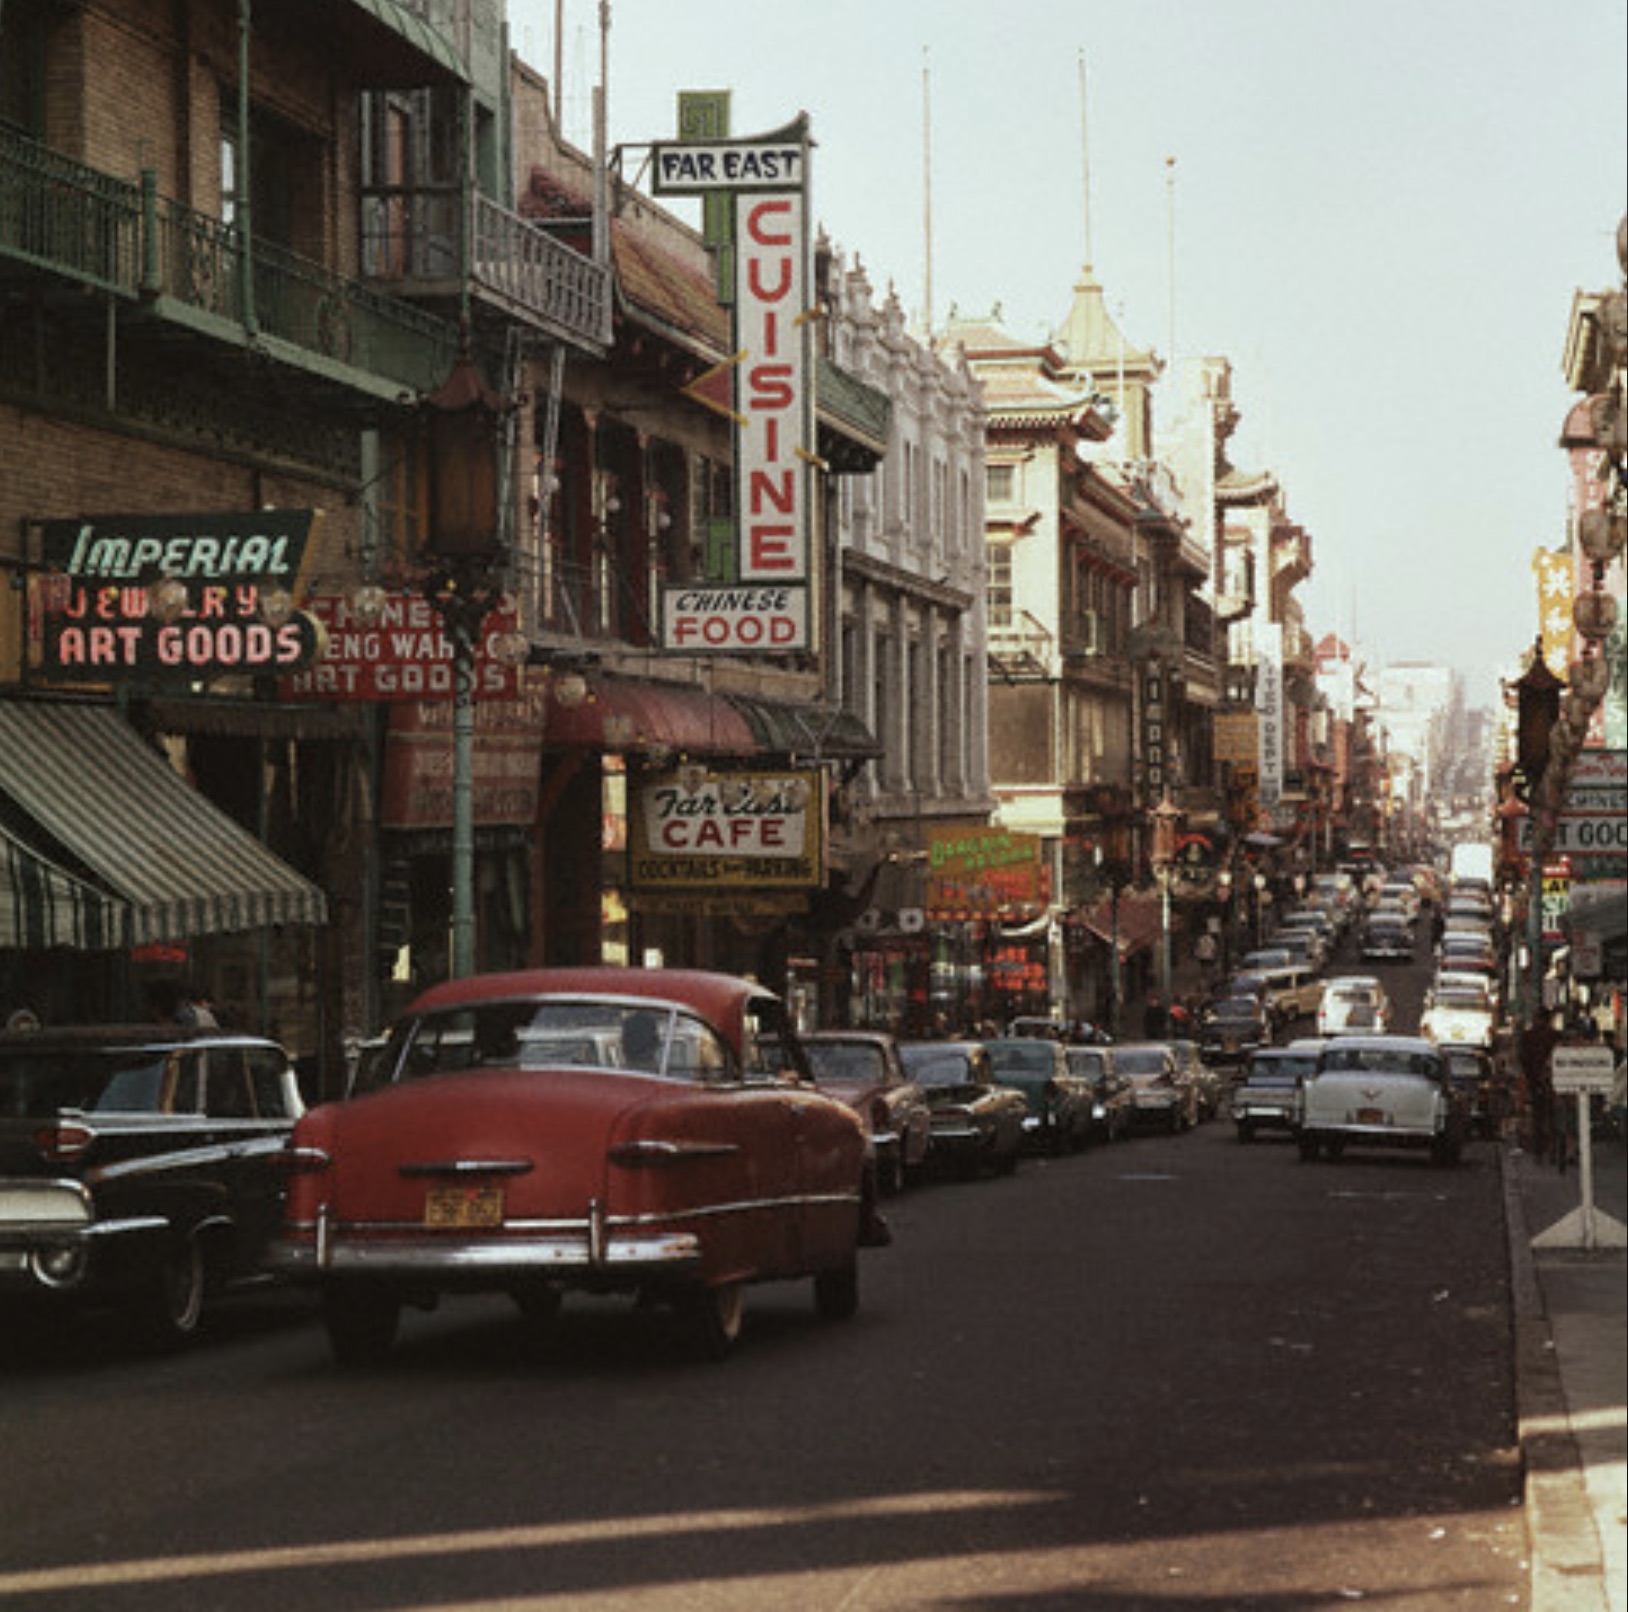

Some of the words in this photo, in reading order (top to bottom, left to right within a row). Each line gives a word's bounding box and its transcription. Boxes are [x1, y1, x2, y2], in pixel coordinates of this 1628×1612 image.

[661, 152, 716, 180] FAR
[723, 150, 800, 179] EAST
[747, 200, 795, 569] CUISINE
[67, 525, 289, 578] IMPERIAL
[65, 585, 258, 619] JEWRY
[676, 589, 789, 612] CHINESE
[59, 626, 142, 665] ART
[157, 623, 301, 665] GOODS
[674, 616, 796, 644] FOOD
[322, 633, 381, 659] ENG
[374, 664, 506, 692] GOOS
[662, 819, 785, 848] CAFE
